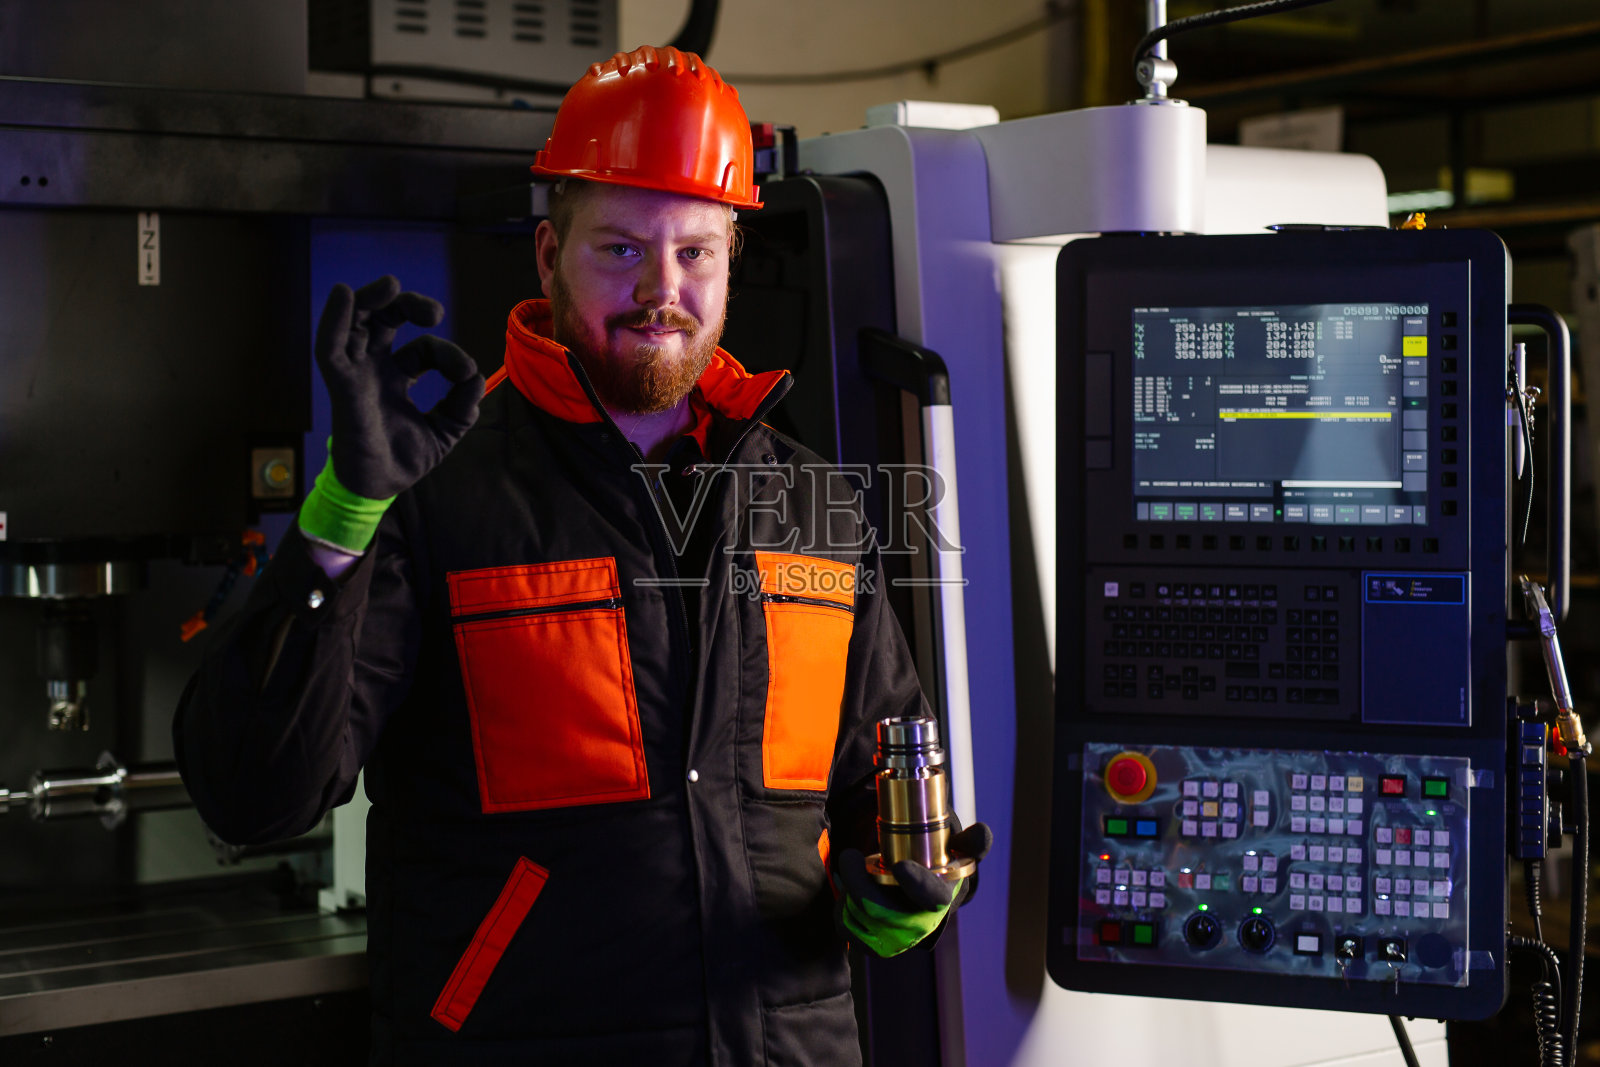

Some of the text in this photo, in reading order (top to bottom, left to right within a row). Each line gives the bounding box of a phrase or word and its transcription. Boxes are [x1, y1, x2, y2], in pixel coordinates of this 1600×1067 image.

[143, 230, 155, 250] Z
[1175, 323, 1223, 332] 259.143
[1266, 322, 1315, 331] 259.143
